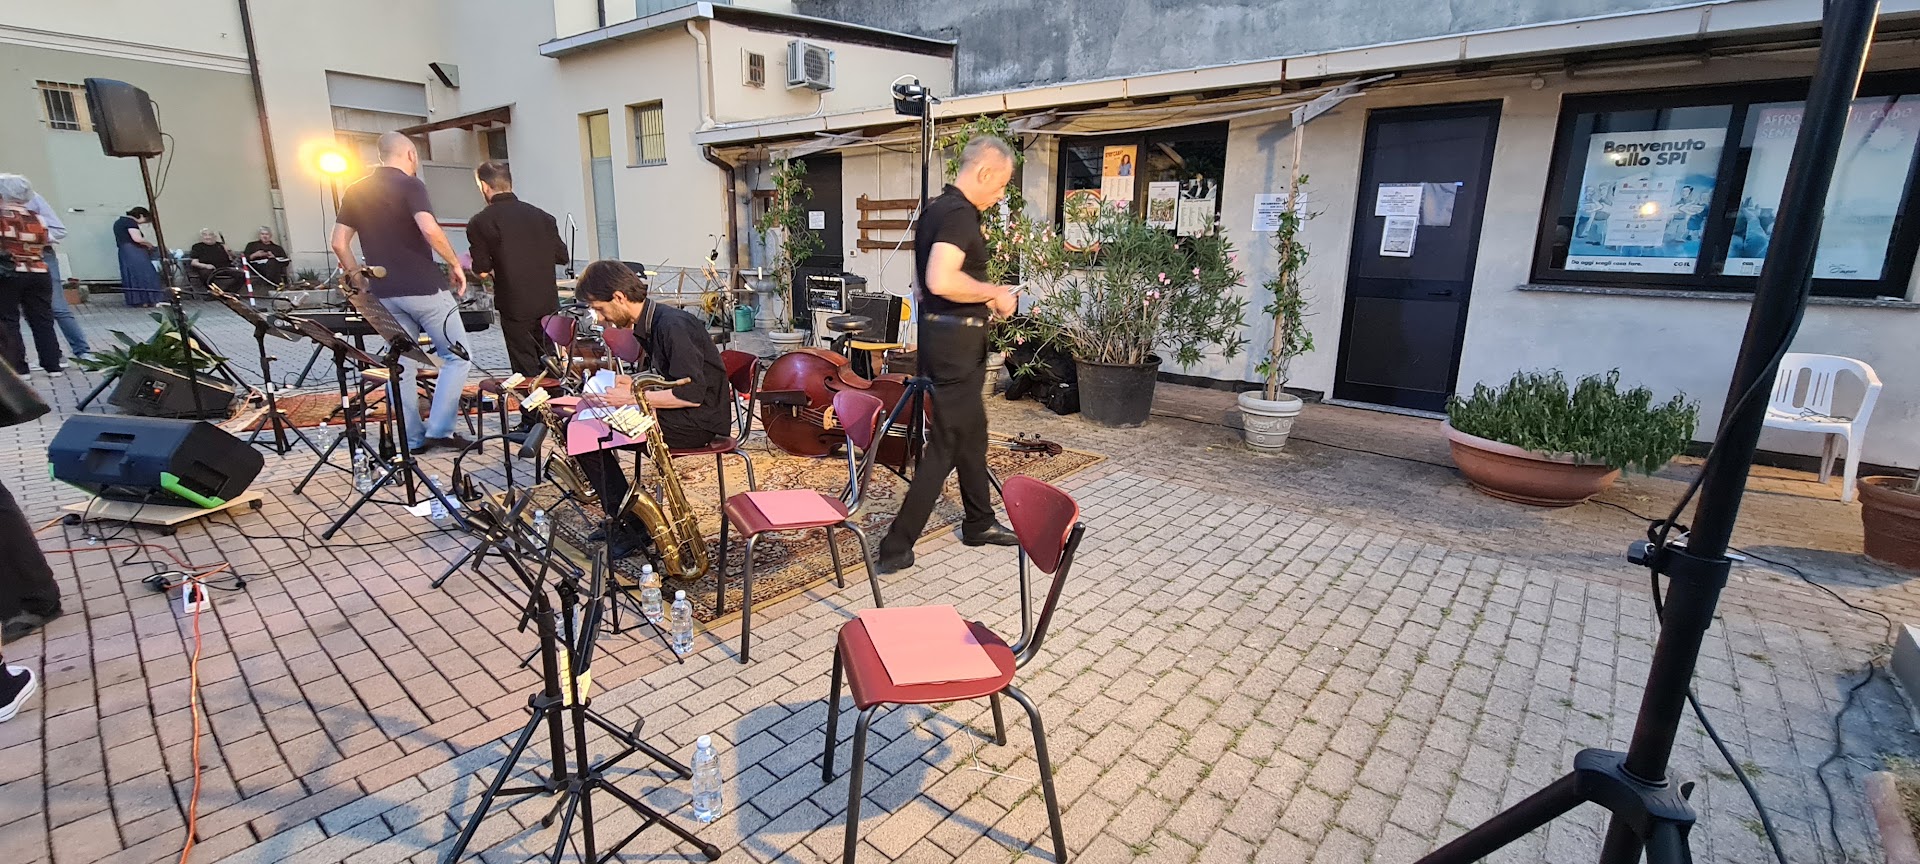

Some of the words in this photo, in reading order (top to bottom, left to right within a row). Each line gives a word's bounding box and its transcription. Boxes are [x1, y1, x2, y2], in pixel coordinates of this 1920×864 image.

[1763, 114, 1802, 127] AFFRO
[1603, 139, 1706, 153] Benvenuto
[1614, 152, 1651, 167] allo
[1655, 152, 1688, 165] SPI
